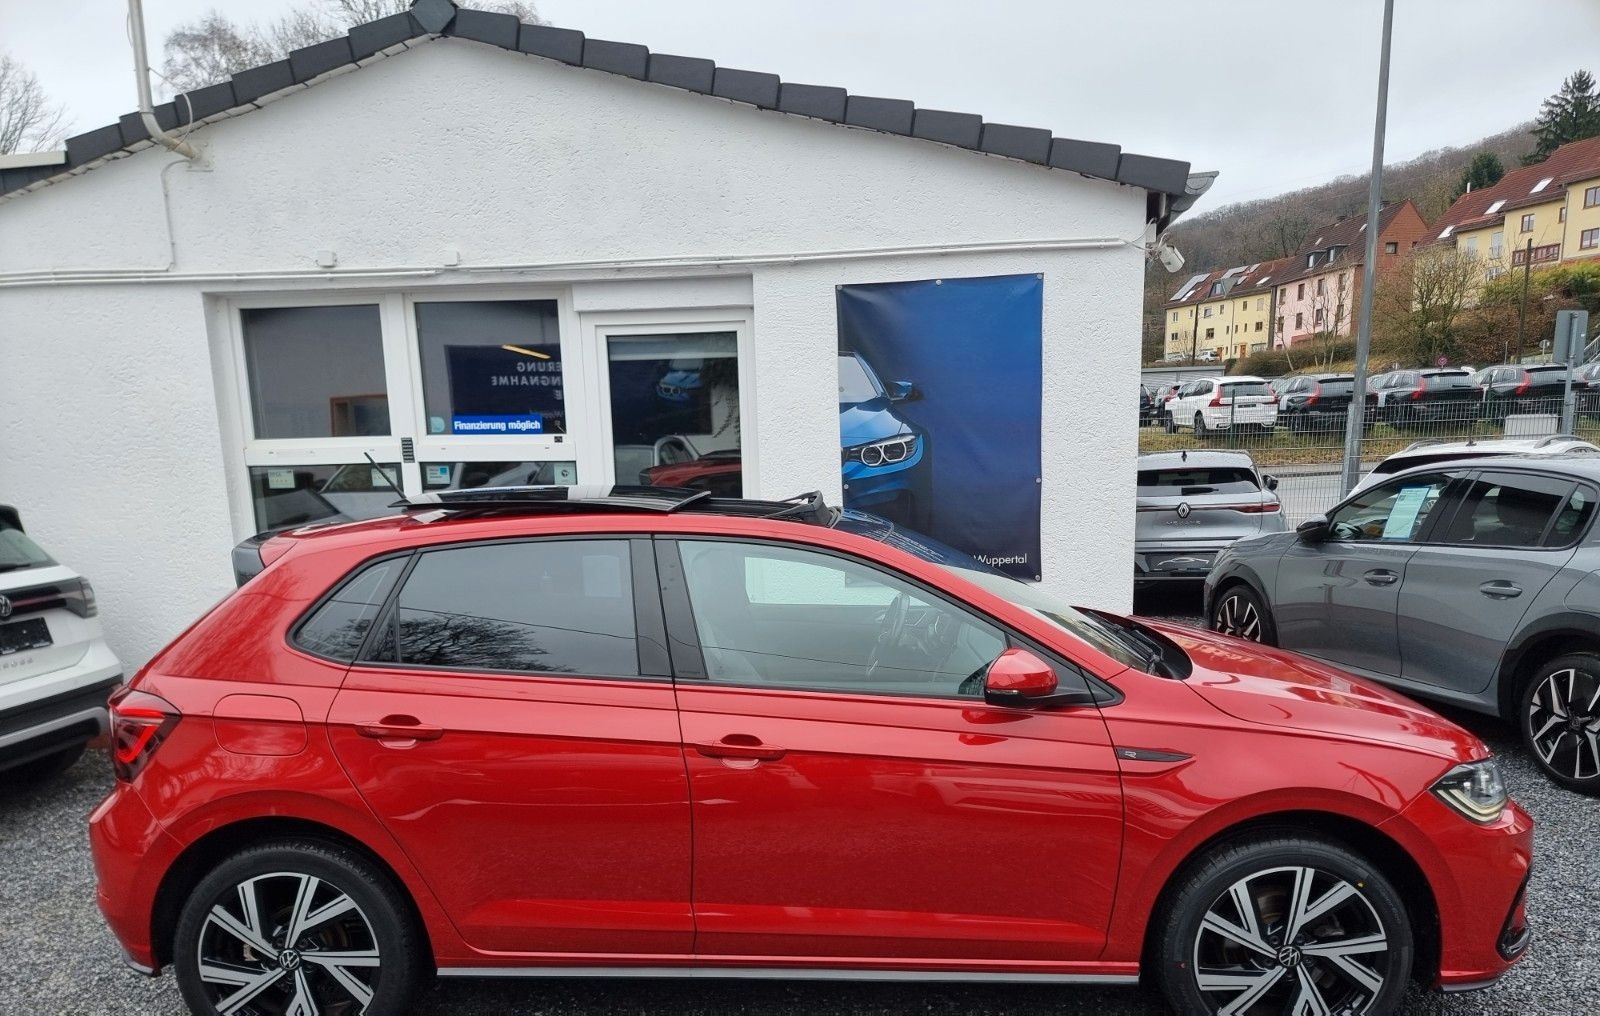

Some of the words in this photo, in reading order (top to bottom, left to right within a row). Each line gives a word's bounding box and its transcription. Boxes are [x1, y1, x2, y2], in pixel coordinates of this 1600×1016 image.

[454, 421, 506, 431] Finanzierung
[508, 420, 540, 431] möglich
[973, 553, 1028, 567] Wuppertal
